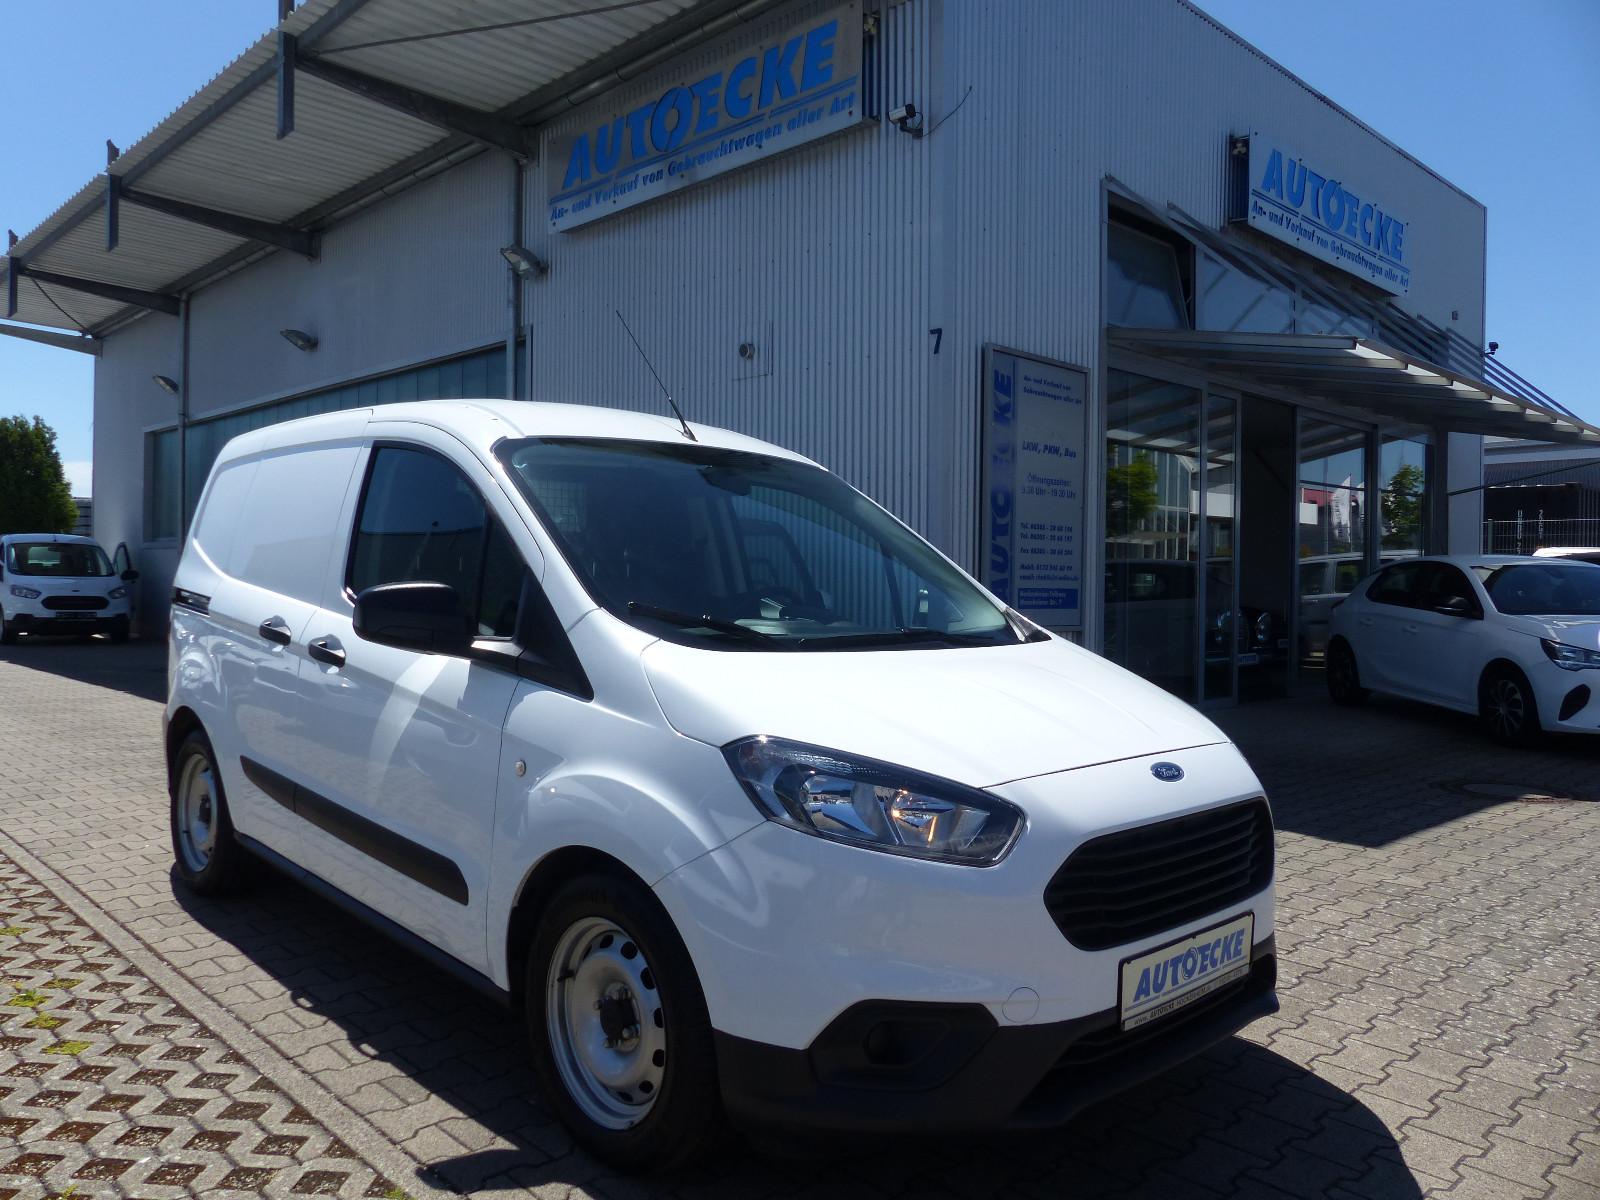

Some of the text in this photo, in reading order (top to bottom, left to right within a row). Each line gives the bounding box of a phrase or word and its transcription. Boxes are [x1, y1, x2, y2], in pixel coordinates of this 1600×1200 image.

[562, 19, 839, 190] AUTOECKE
[572, 194, 592, 213] und
[595, 173, 641, 202] Verkauf
[642, 168, 664, 186] von
[667, 123, 783, 176] Gebrauchtwagen
[786, 107, 825, 131] aller
[829, 93, 856, 116] Art
[1261, 148, 1404, 262] AUTOECKE
[1268, 211, 1285, 227] und
[1285, 216, 1316, 243] Verkauf
[1316, 235, 1329, 250] von
[1330, 240, 1383, 276] Gebrauchtwagen
[1384, 267, 1399, 283] aller
[929, 327, 943, 355] 7
[1064, 447, 1077, 459] Bus
[1132, 928, 1246, 1004] AUTOECKE
